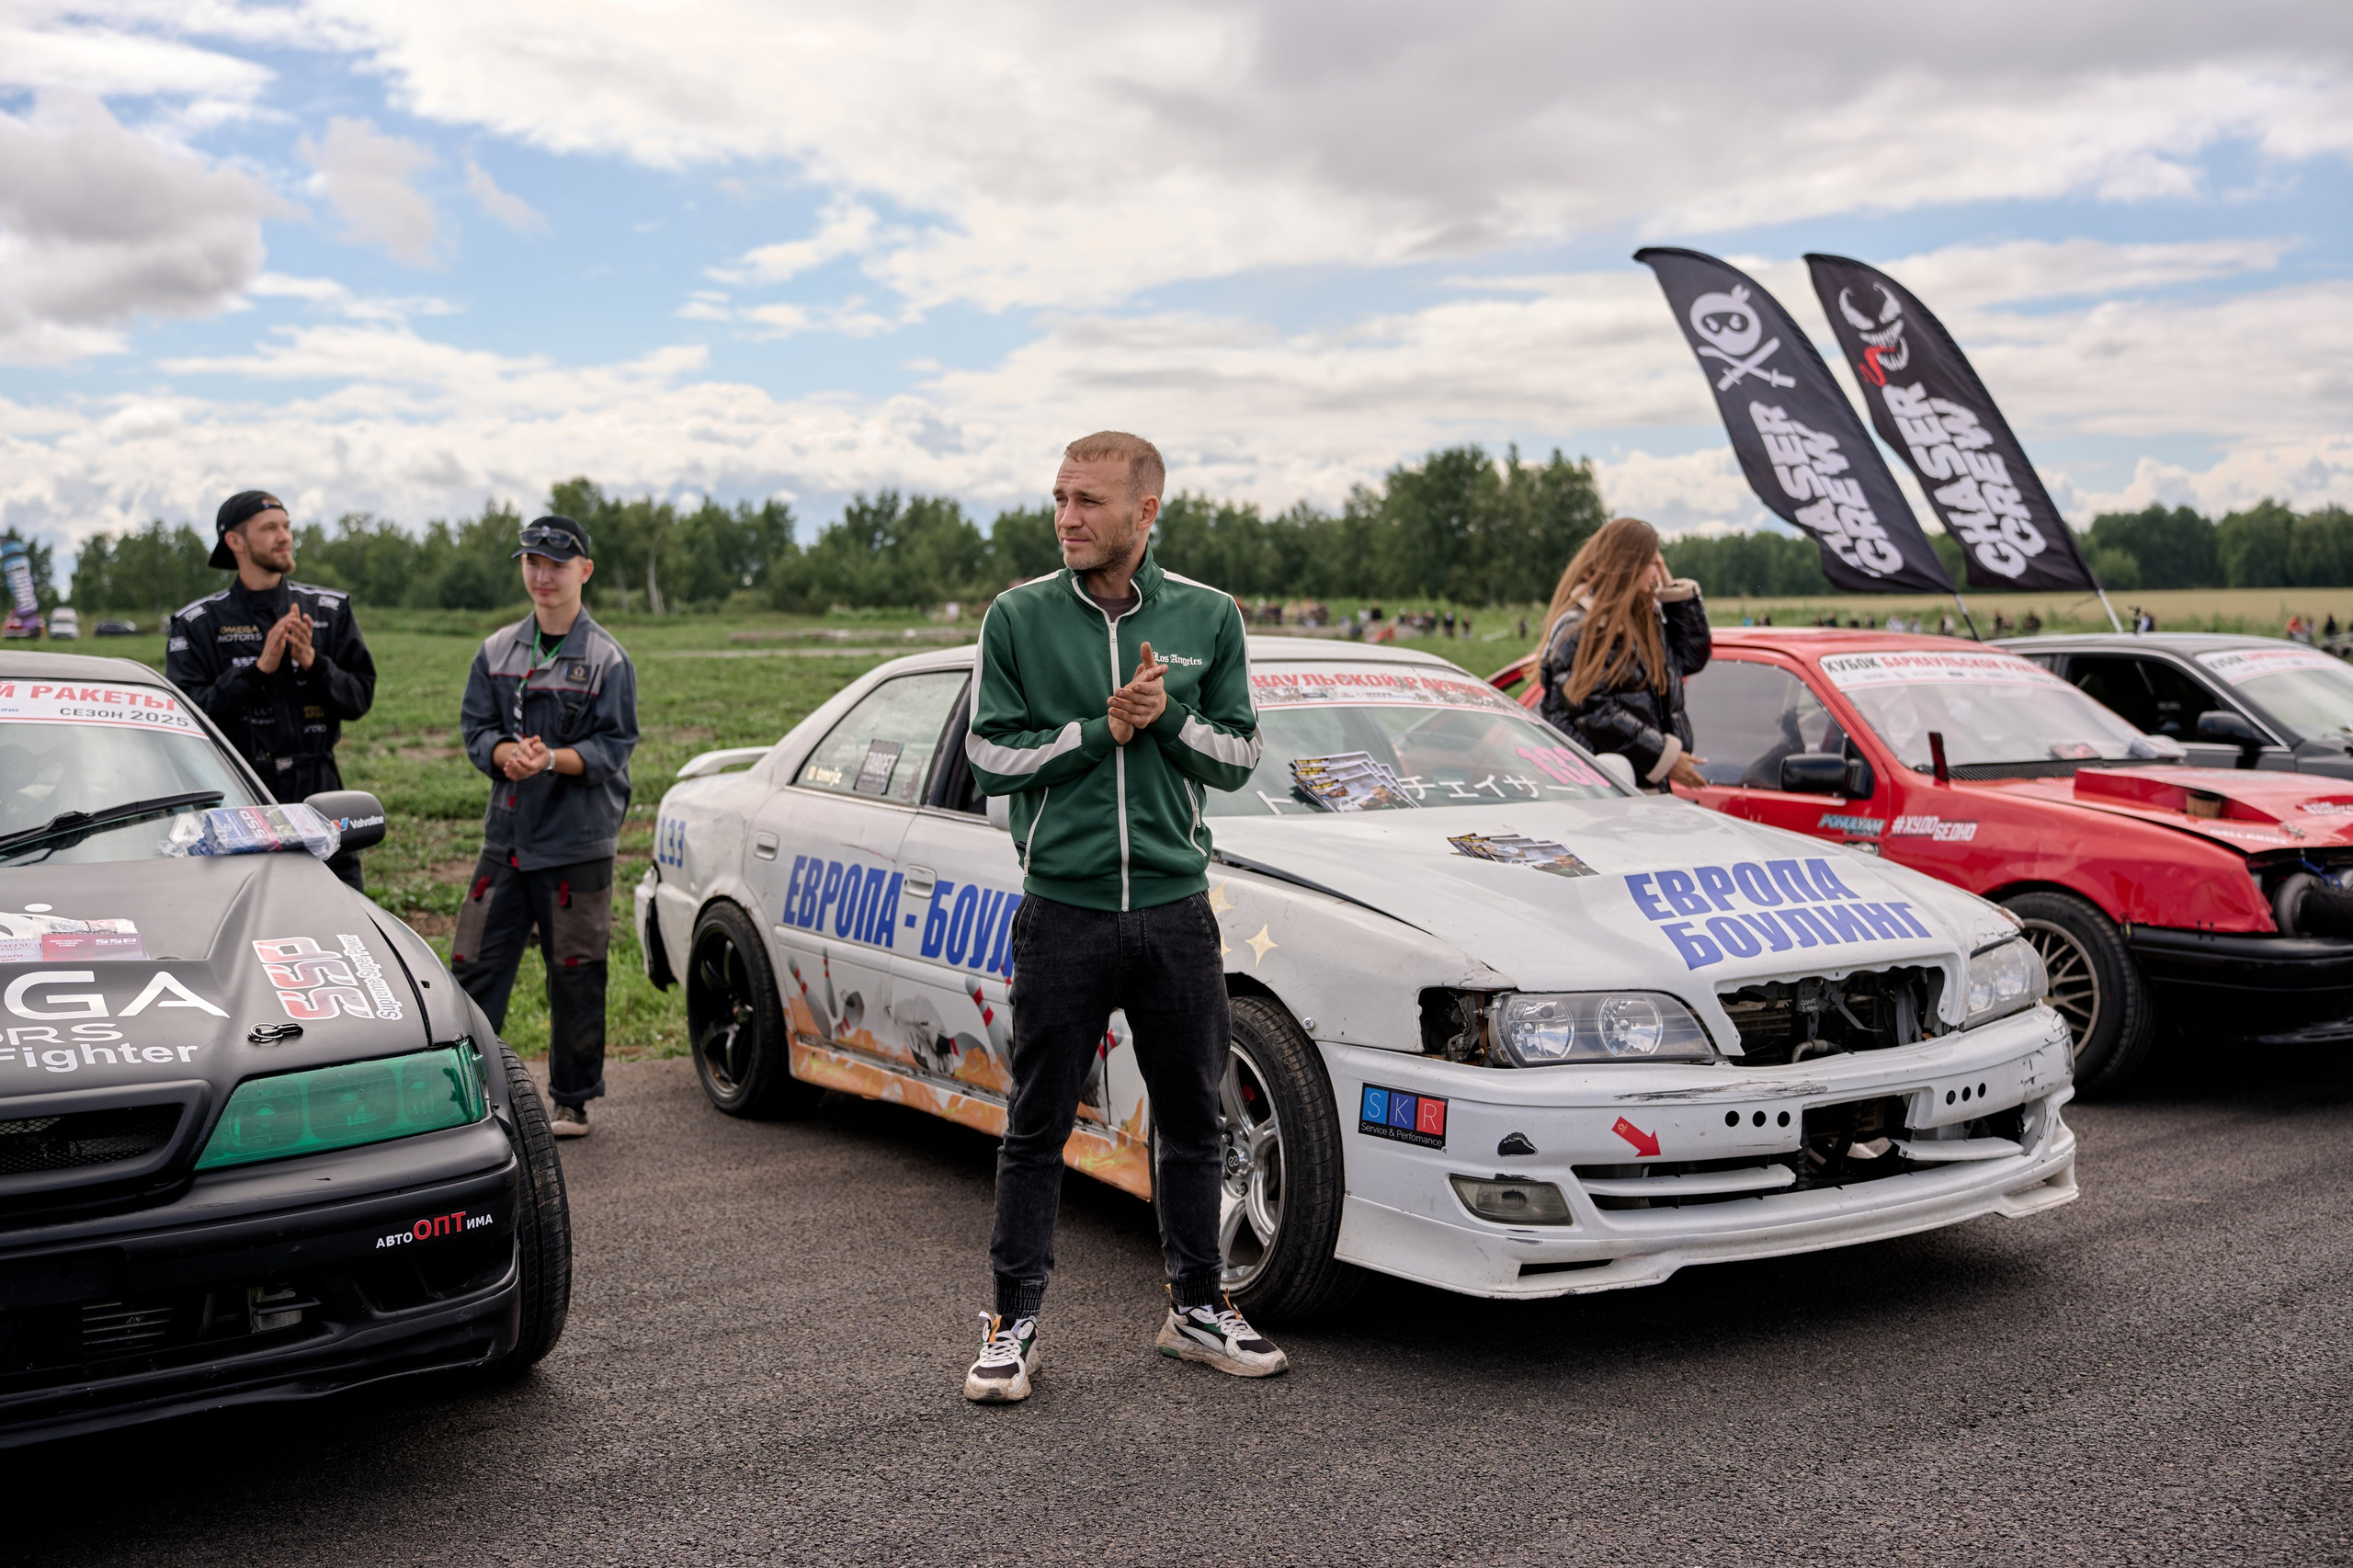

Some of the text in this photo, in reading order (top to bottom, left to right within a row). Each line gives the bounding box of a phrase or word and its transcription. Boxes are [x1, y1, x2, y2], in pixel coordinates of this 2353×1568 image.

[1749, 401, 1881, 577] HASER
[1793, 418, 1904, 575] CREW
[1881, 381, 2027, 579] CHASER
[1930, 396, 2048, 558] CREW
[217, 633, 263, 642] MOTORS
[220, 625, 260, 634] OMEGA
[1153, 651, 1202, 667] Los Angeles
[30, 685, 176, 711] РАКЕТЫ
[60, 707, 189, 727] СЕЗОН 2025
[348, 814, 385, 830] Valvoline
[1623, 858, 1861, 921] ЕВРОПА
[1660, 902, 1933, 971] БОУЛИНГ
[4, 970, 231, 1020] GA
[252, 937, 376, 1020] SSP
[0, 1023, 124, 1045] RS
[1361, 1122, 1388, 1135] Service
[1388, 1128, 1395, 1137] &
[1367, 1092, 1437, 1131] SKR
